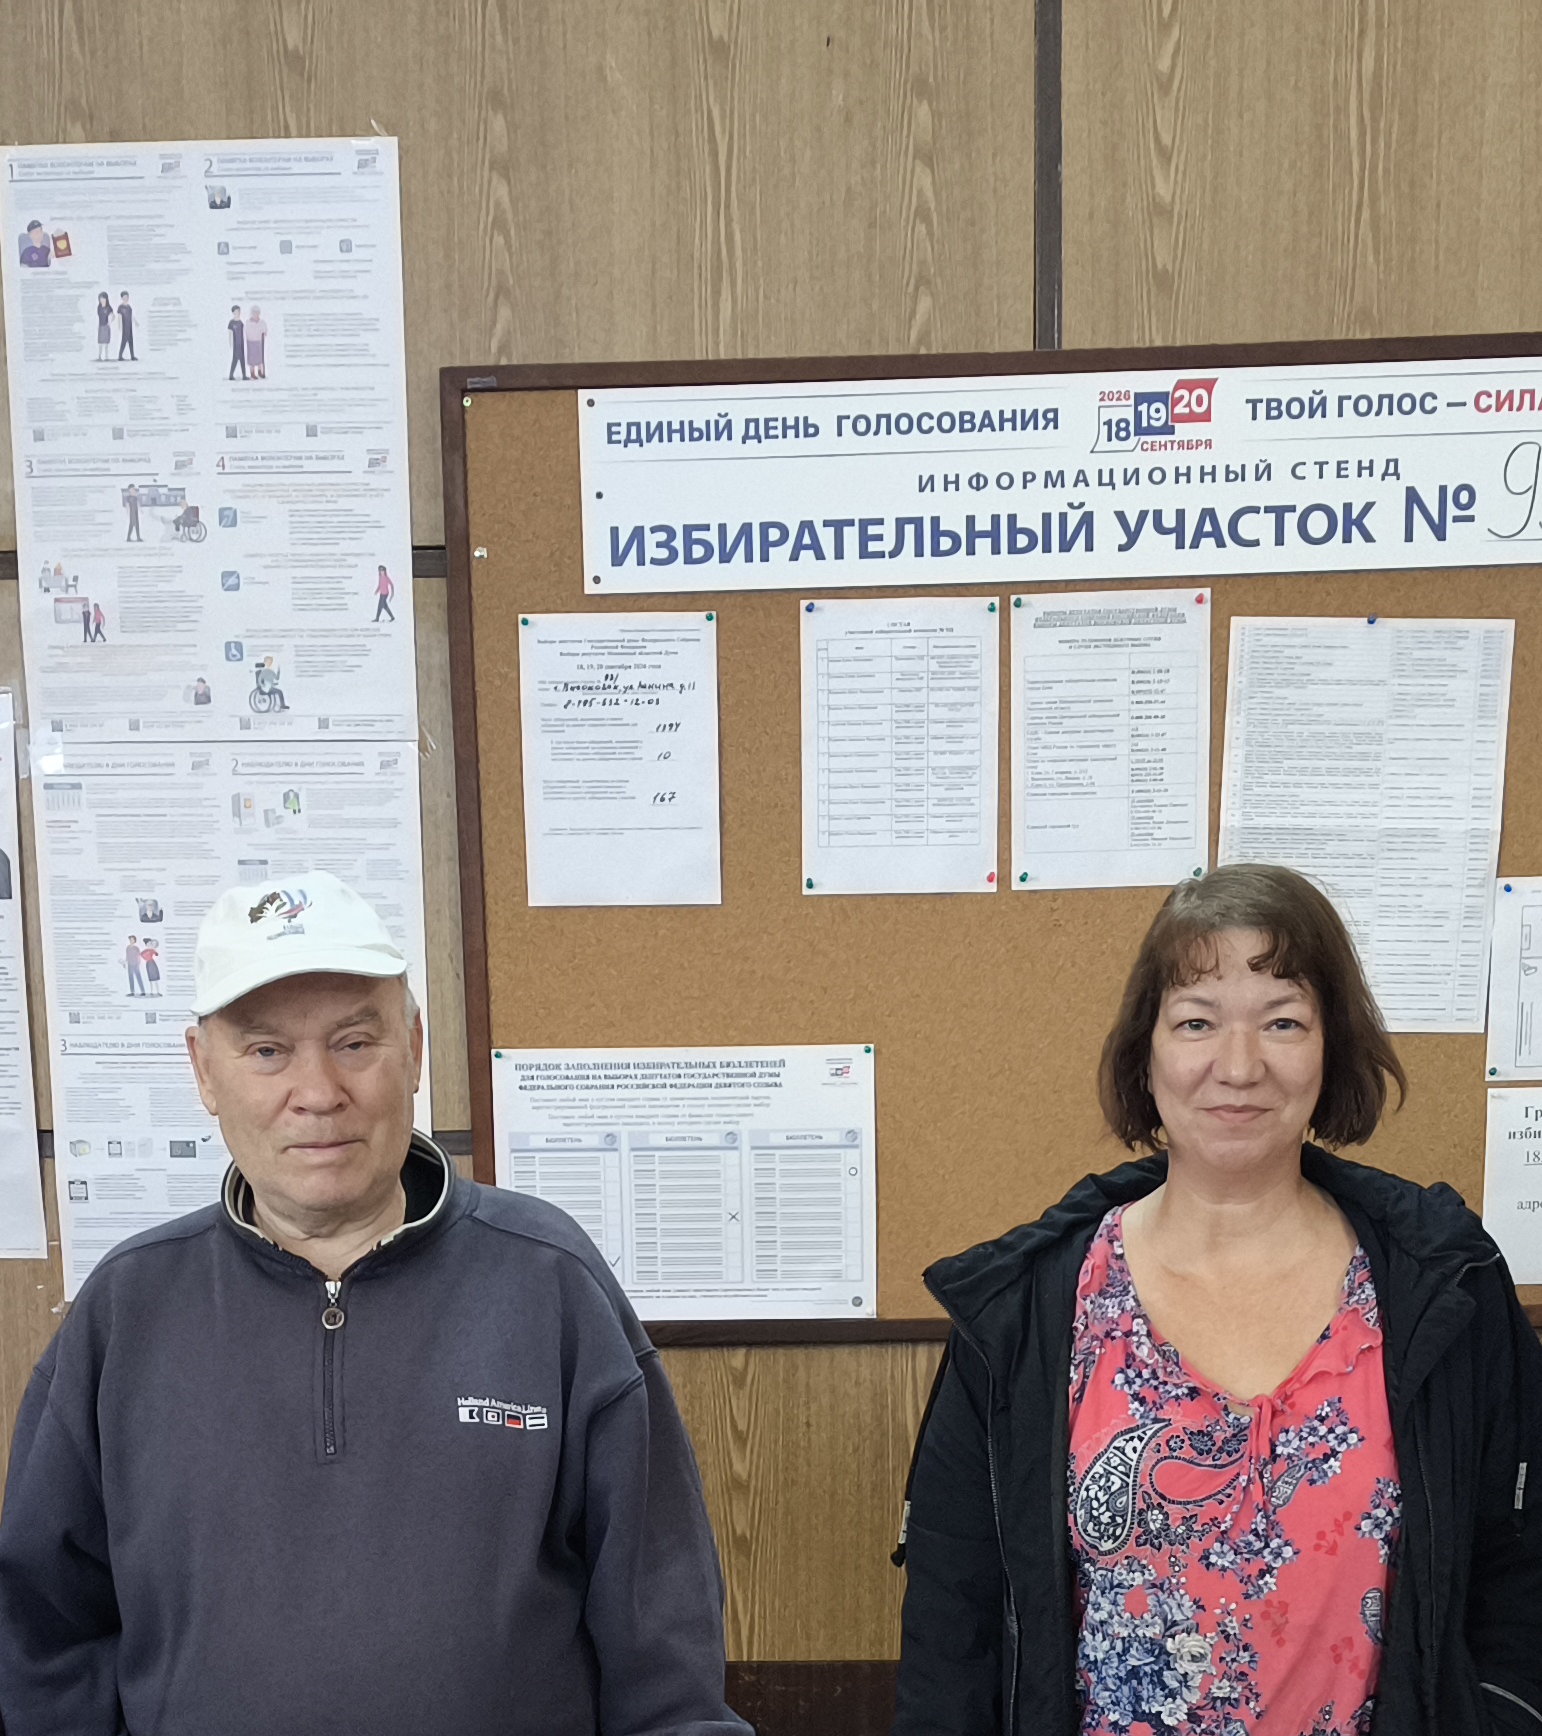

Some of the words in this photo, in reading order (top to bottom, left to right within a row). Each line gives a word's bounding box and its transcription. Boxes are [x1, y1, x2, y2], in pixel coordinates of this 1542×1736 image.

[1099, 390, 1130, 401] 2026
[1173, 388, 1208, 414] 20
[1246, 389, 1327, 421] ТВОЙ
[1338, 391, 1438, 418] ГОЛОС
[1138, 402, 1166, 427] 19
[605, 414, 736, 449] ЕДИНЫЙ
[742, 415, 820, 445] ДЕНЬ
[836, 407, 1059, 440] ГОЛОСОВАНИЯ
[1103, 418, 1131, 442] 18
[1141, 439, 1212, 452] СЕНТЯБРЯ
[216, 456, 225, 471] 4
[918, 460, 1272, 494] ИНФОРМАЦИОННЫЙ
[1290, 457, 1402, 482] СТЕНД
[610, 503, 1094, 568] ИЗБИРАТЕЛЬНЫЙ
[1114, 501, 1376, 551] УЧАСТОК
[1403, 483, 1476, 543] №
[657, 751, 671, 761] 10
[652, 791, 676, 804] 167
[515, 1063, 561, 1071] ПОРЯДОК
[564, 1062, 630, 1071] ЗАПОЛНЕНИЯ
[633, 1061, 717, 1070] ИЗБИРАТЕЛЬНЫХ
[720, 1059, 786, 1069] БЮЛЛЕТЕНЕЙ
